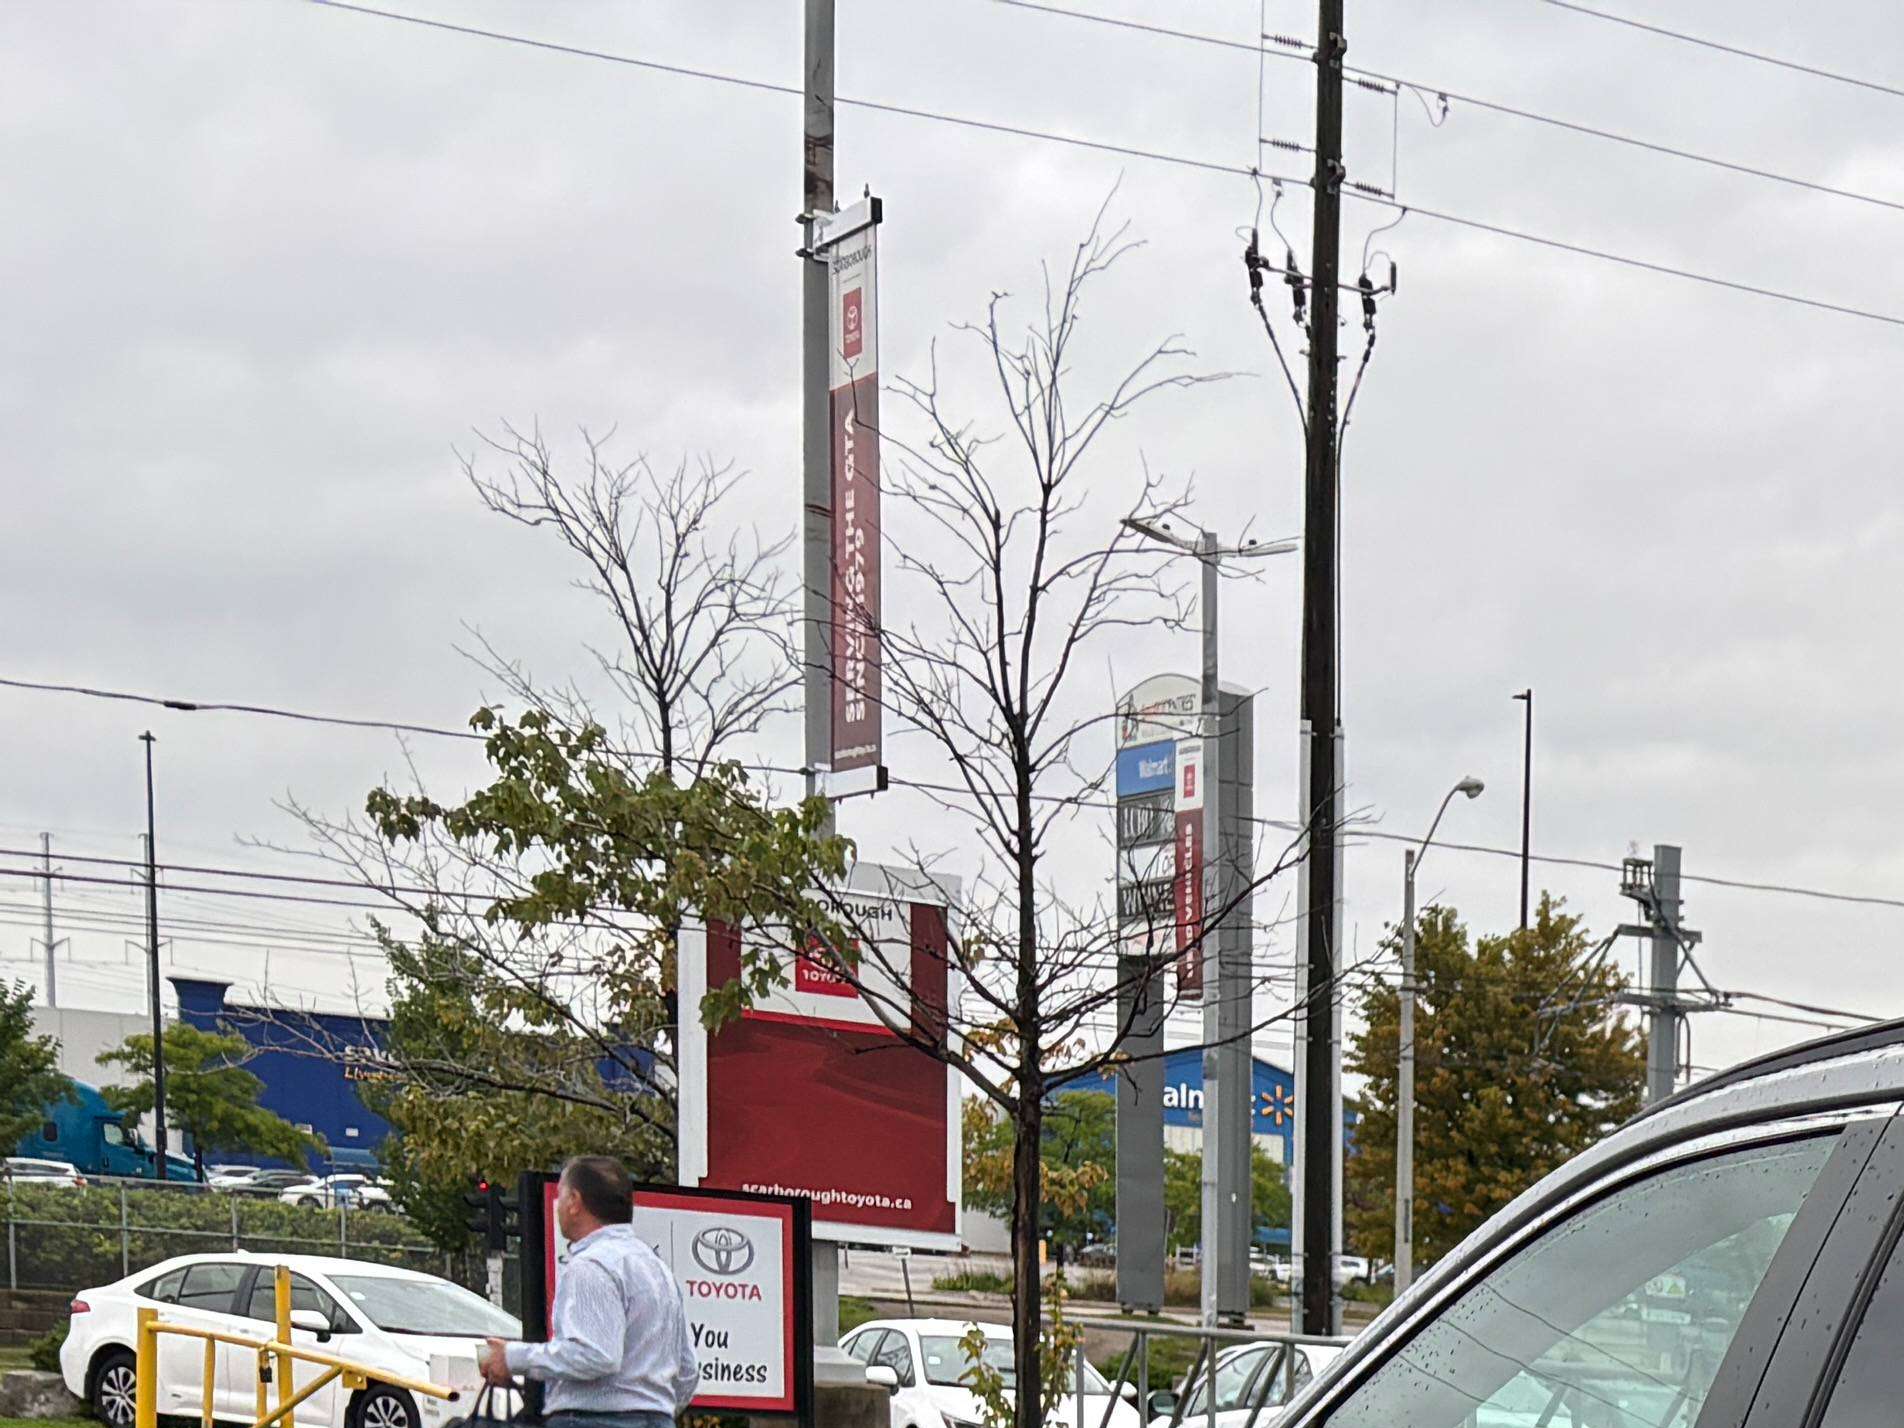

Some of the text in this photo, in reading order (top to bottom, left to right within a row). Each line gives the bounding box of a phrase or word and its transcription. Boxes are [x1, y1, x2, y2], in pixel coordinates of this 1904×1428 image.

[844, 406, 856, 482] GTA
[844, 489, 856, 560] THE
[686, 1279, 762, 1302] TOYOTA
[691, 1321, 729, 1350] You
[699, 1357, 767, 1384] siness
